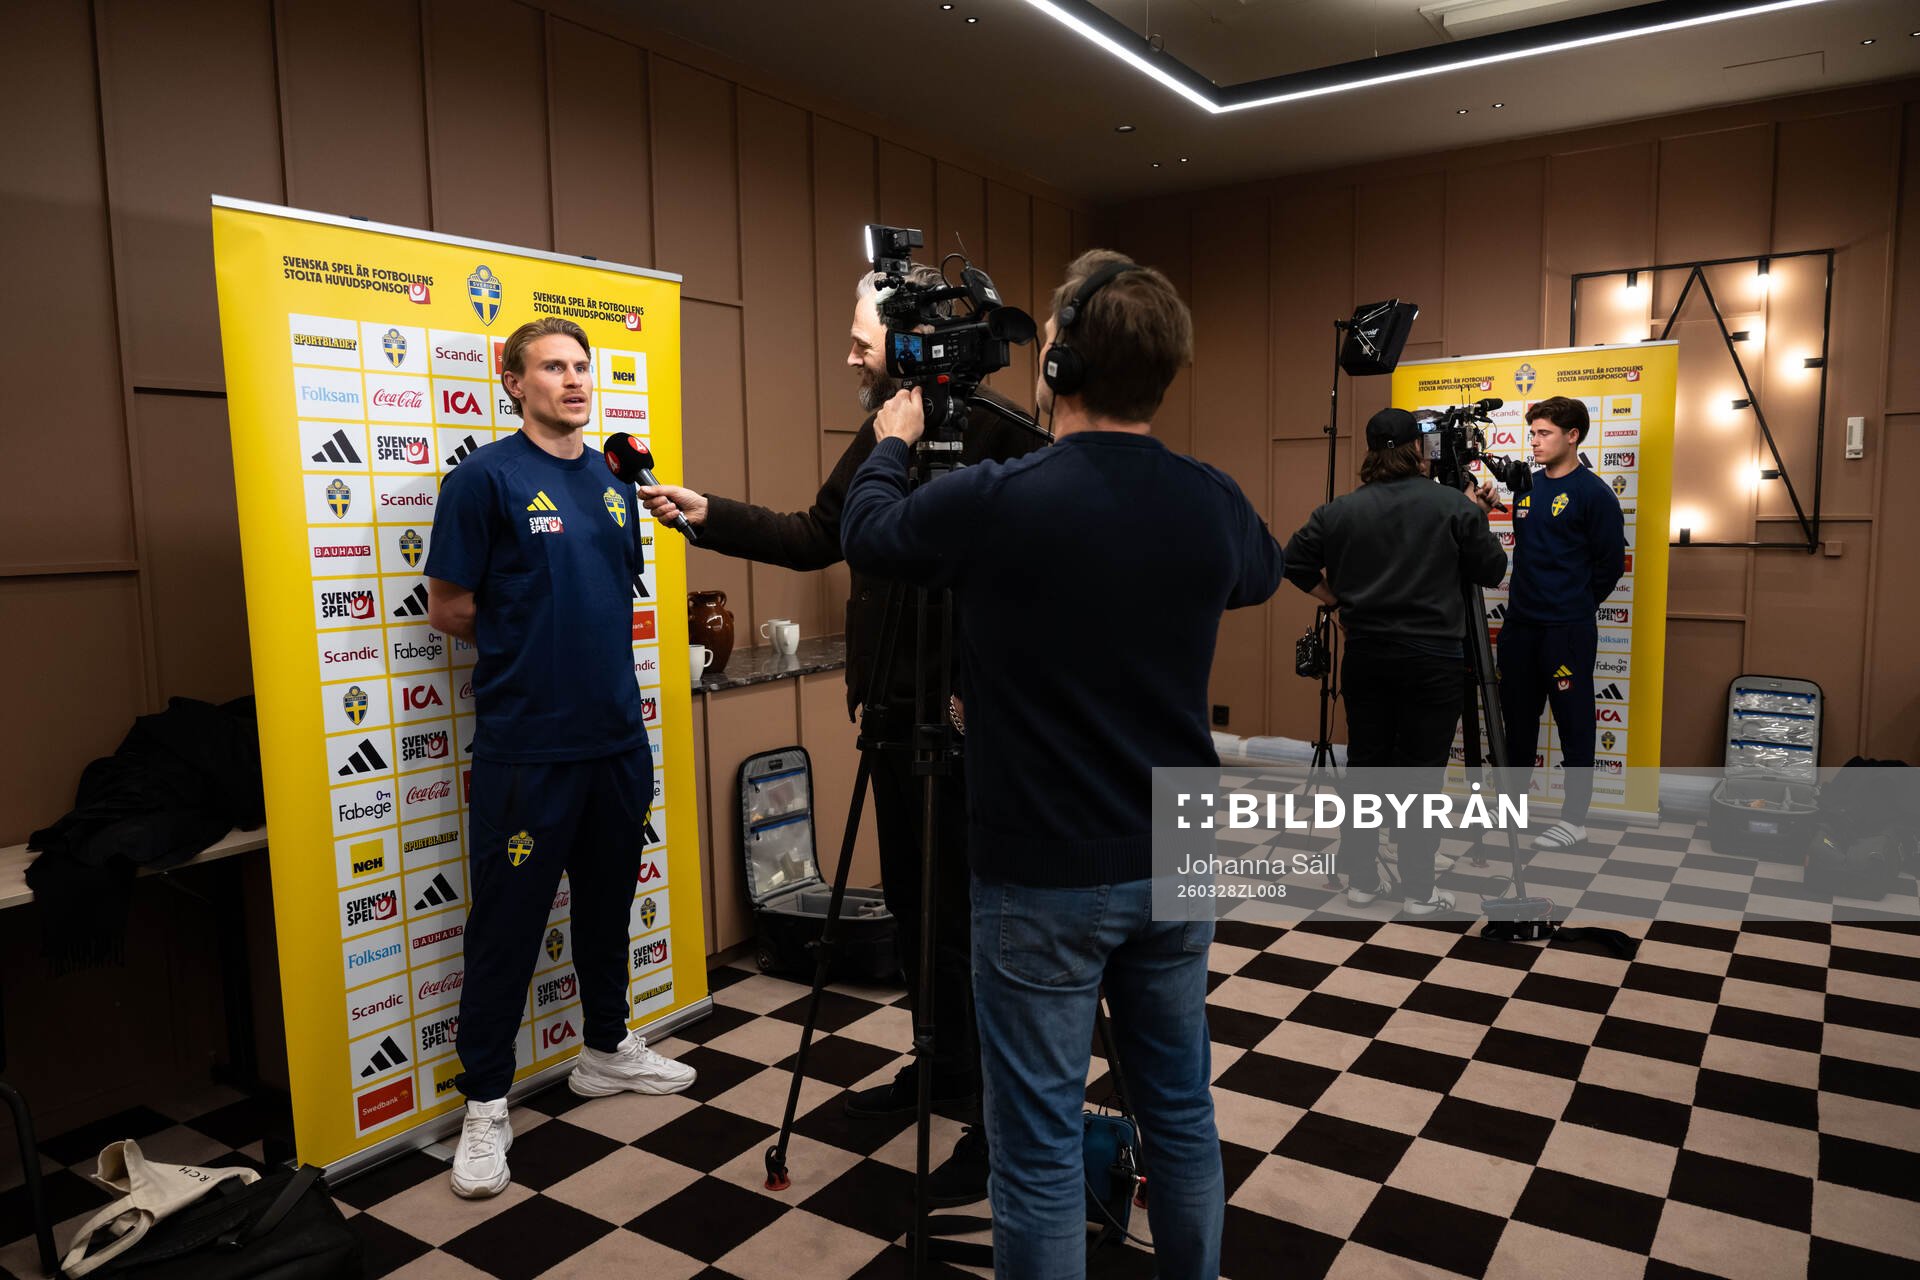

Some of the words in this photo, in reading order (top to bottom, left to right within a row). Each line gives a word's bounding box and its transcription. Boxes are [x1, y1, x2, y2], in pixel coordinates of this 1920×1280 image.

[283, 255, 329, 272] SVENSKA
[332, 262, 354, 276] SPEL
[357, 264, 370, 278] ÄR
[372, 268, 434, 287] FOTBOLLENS
[284, 268, 323, 283] STOLTA
[325, 274, 410, 295] HUVUDSPONSOR
[533, 291, 567, 306] SVENSKA
[568, 296, 585, 309] SPEL
[587, 298, 597, 310] ÄR
[598, 301, 644, 315] FOTBOLLENS
[534, 302, 561, 315] STOLTA
[563, 307, 627, 323] HUVUDSPONSOR
[294, 333, 357, 351] SPORTBLADET
[436, 346, 483, 363] Scandic
[1557, 369, 1581, 377] SVENSKA
[302, 385, 360, 404] Folksam
[443, 390, 483, 415] ICA
[605, 408, 646, 419] BAUHAUS
[377, 435, 429, 449] SVENSKA
[1492, 432, 1516, 445] ICA
[378, 447, 405, 461] SPEL
[1604, 452, 1635, 460] SVENSKA
[381, 493, 434, 506] Scandic
[530, 525, 550, 535] SPEL
[314, 545, 371, 558] BAUHAUS
[321, 590, 374, 605] SVENSKA
[322, 604, 350, 618] SPEL
[324, 646, 378, 664] Scandic
[394, 642, 443, 660] Fabege
[1596, 660, 1627, 673] Fabege
[403, 684, 443, 711] ICA
[1596, 709, 1622, 723] ICA
[402, 730, 448, 750] SVENSKA
[403, 747, 427, 761] SPEL
[339, 801, 392, 822] Fabege
[404, 831, 458, 853] SPORTBLADET
[637, 862, 661, 883] CA
[346, 890, 397, 914] SVENSKA
[347, 909, 374, 926] SPEL
[413, 925, 463, 949] BAUHAUS
[348, 943, 402, 969] Folksam
[633, 938, 667, 959] SVENSKA
[634, 955, 652, 969] SPEL
[537, 972, 576, 996] SVENSKA
[352, 994, 403, 1021] Scandic
[538, 990, 560, 1007] SPEL
[422, 1033, 448, 1051] SPEL
[542, 1019, 577, 1049] ICA
[362, 1096, 399, 1116] Swedbank
